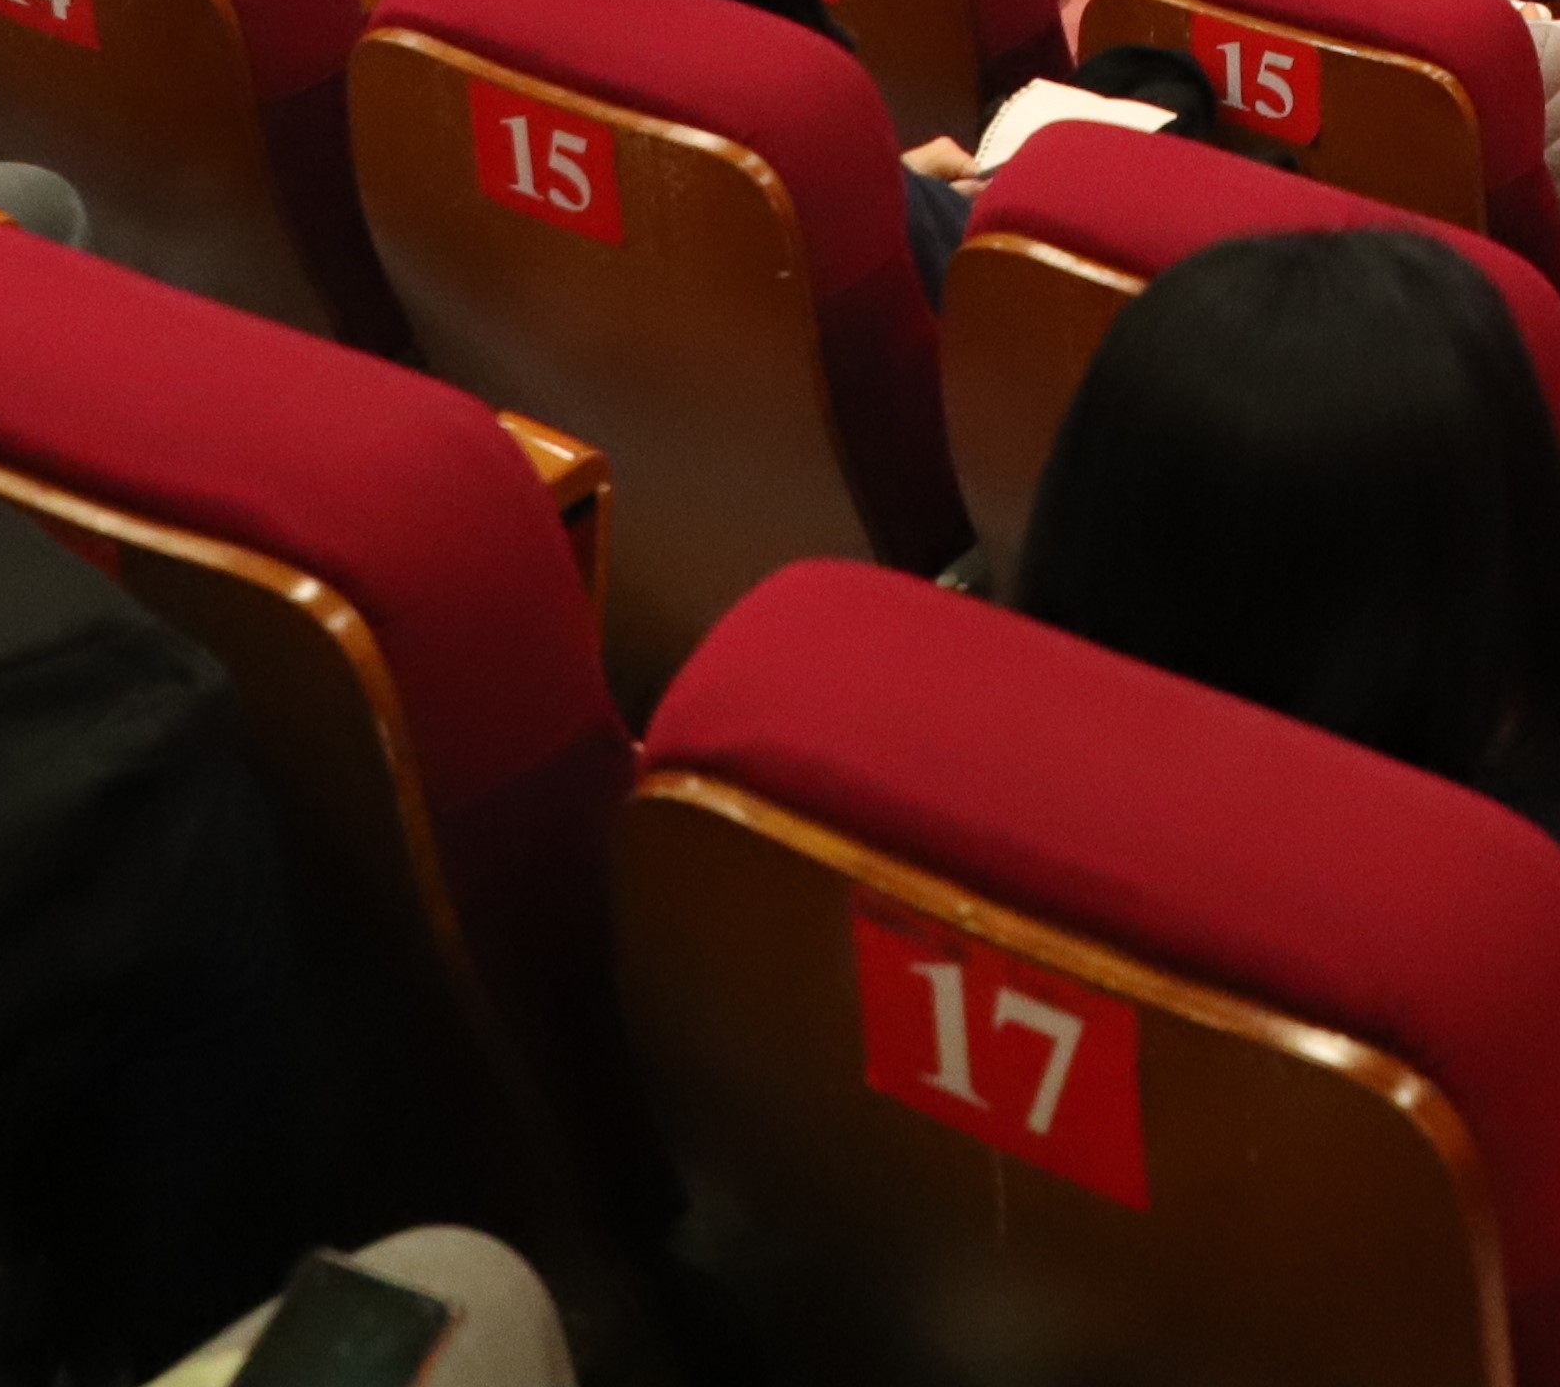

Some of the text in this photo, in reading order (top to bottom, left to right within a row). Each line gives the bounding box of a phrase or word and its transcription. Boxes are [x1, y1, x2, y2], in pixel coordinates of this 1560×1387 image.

[1215, 42, 1295, 119] 15
[499, 116, 592, 211] 15
[910, 962, 1083, 1134] 17
